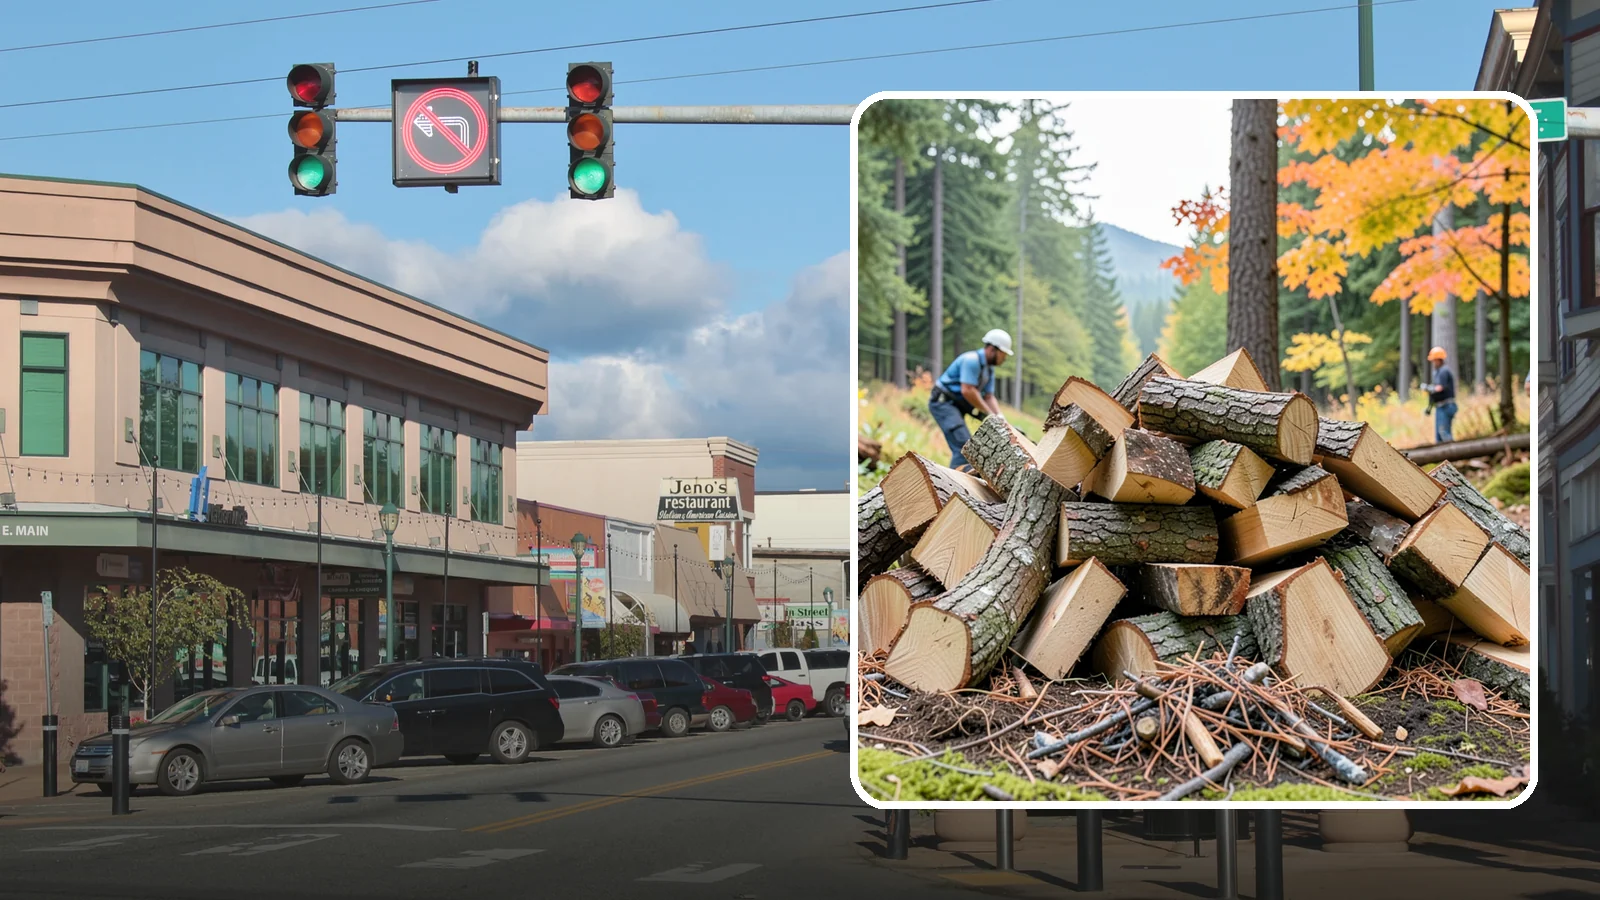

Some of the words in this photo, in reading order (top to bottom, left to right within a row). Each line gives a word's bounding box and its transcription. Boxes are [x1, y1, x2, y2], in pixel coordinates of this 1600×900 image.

[669, 480, 727, 494] Jeno's
[665, 496, 731, 509] restaurant
[686, 509, 714, 519] American
[715, 509, 737, 519] Cuisine
[2, 525, 13, 536] E.
[15, 525, 49, 536] MAIN
[797, 607, 828, 617] Street
